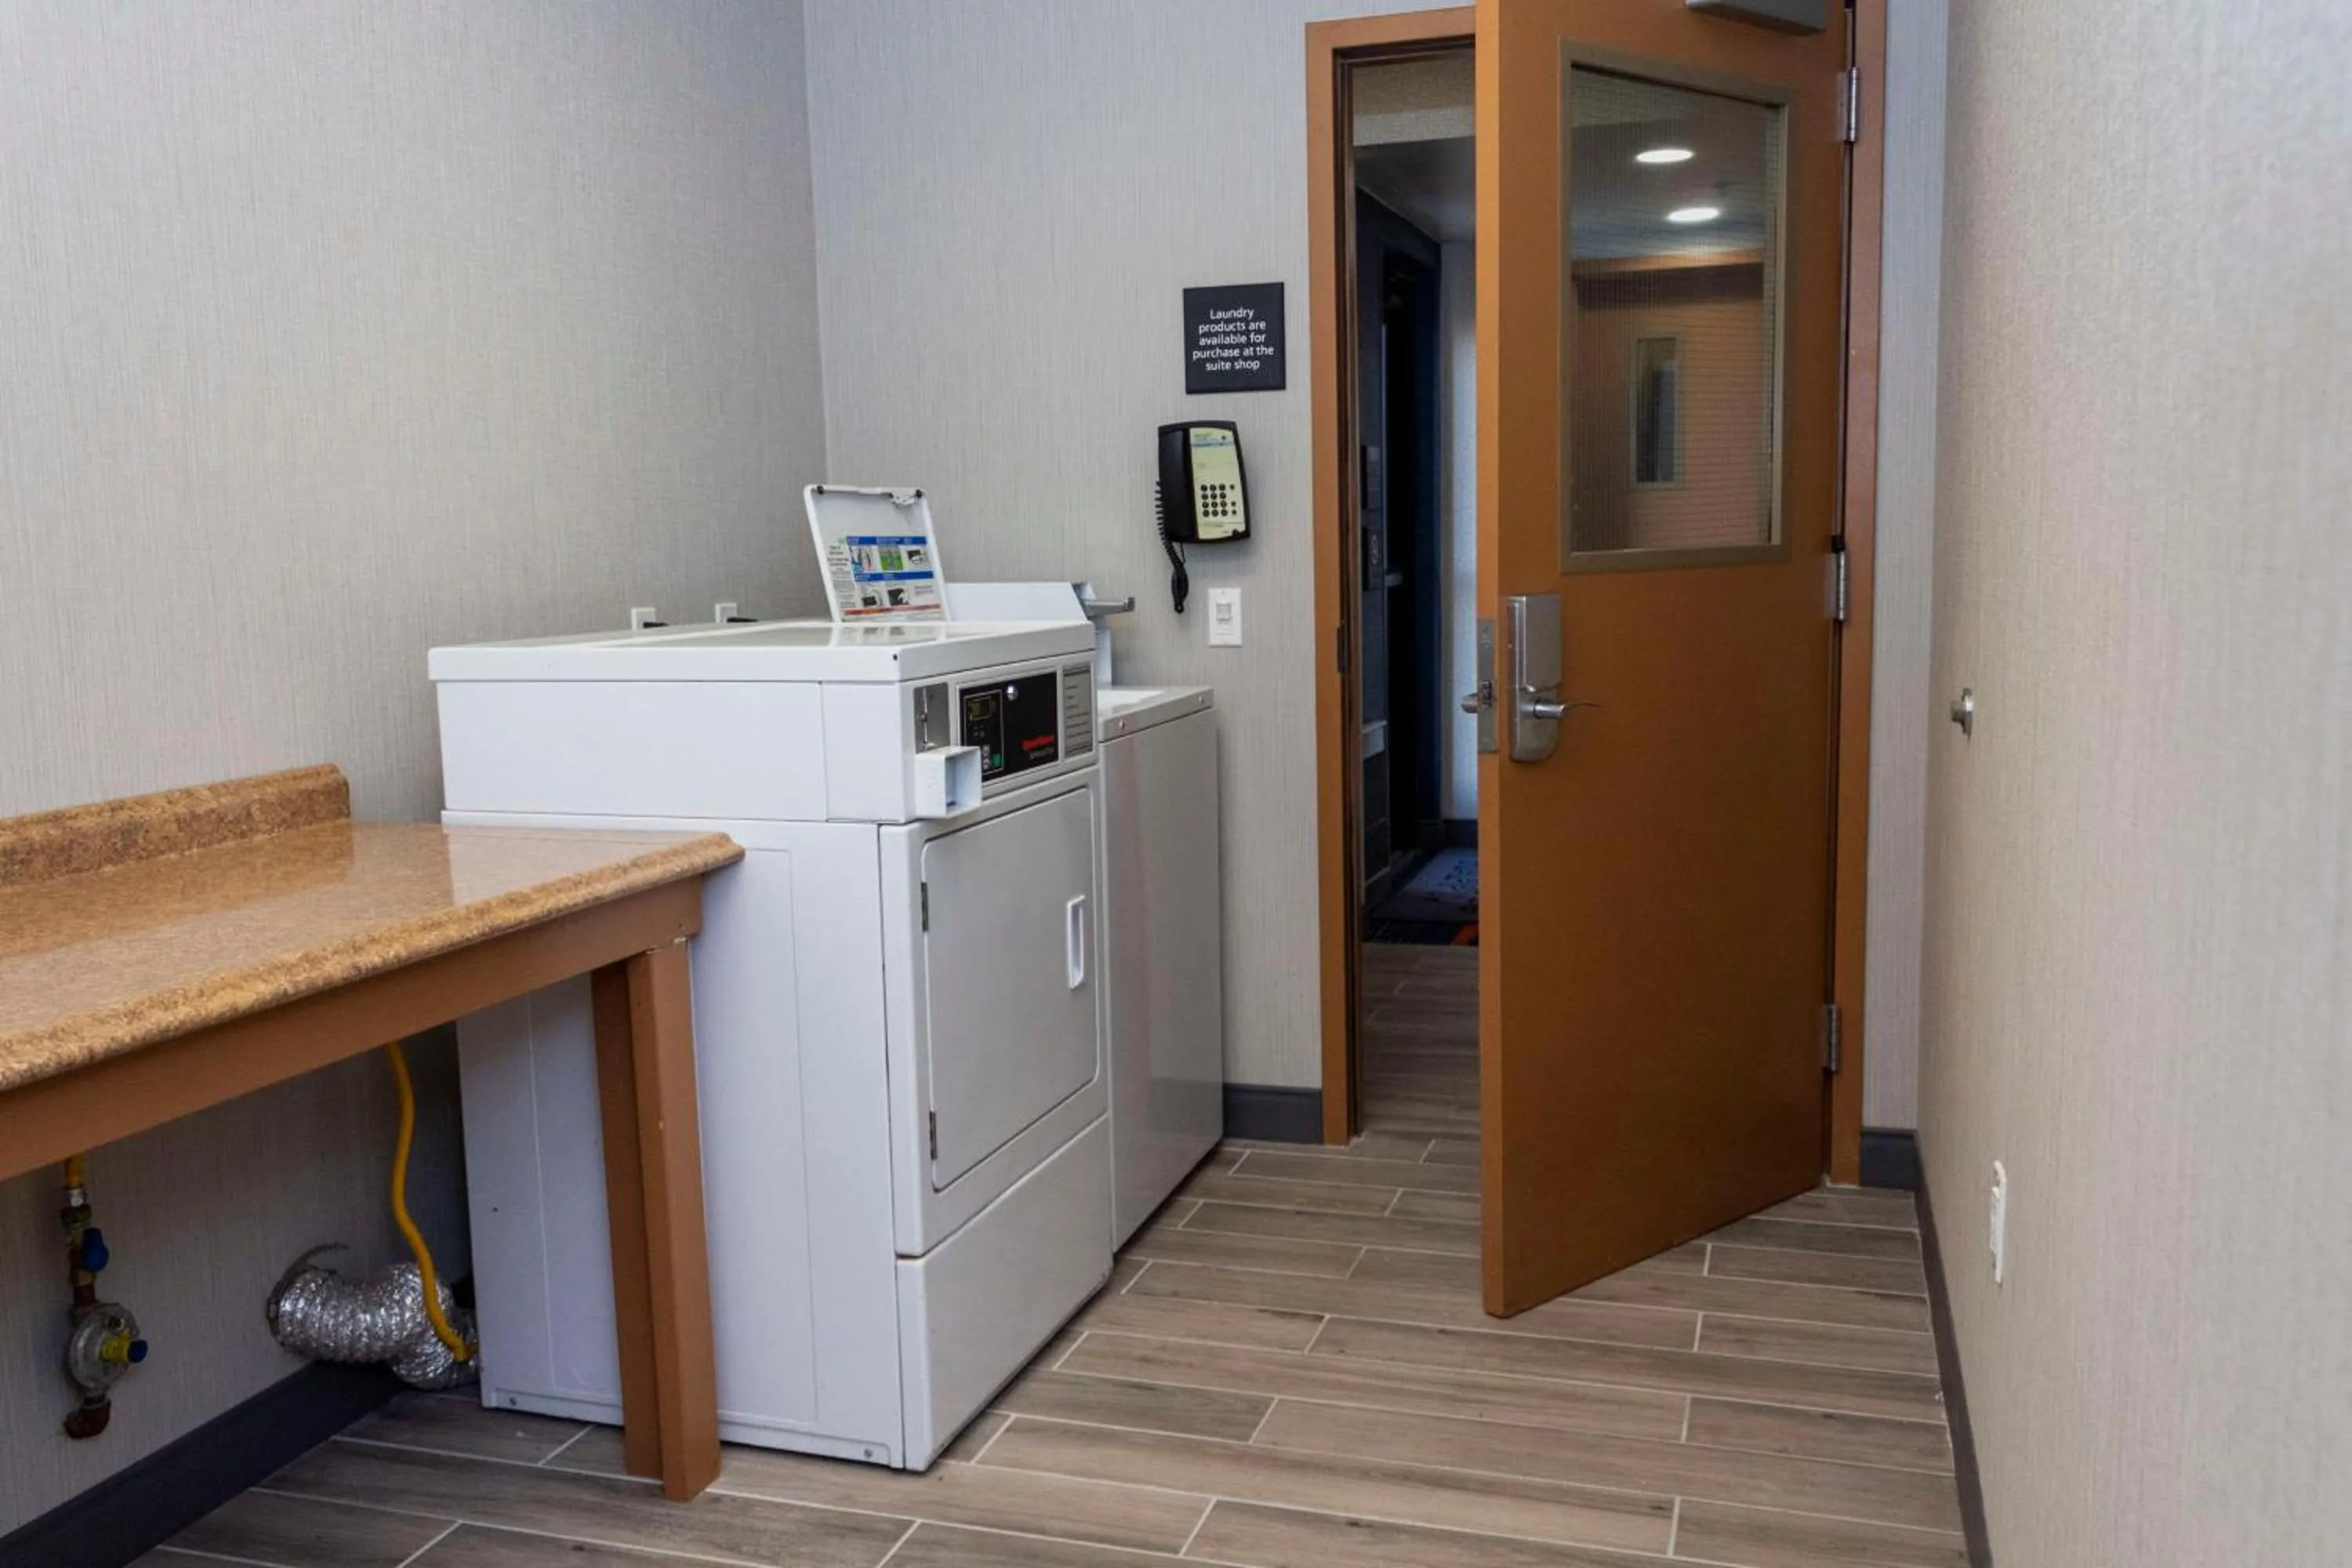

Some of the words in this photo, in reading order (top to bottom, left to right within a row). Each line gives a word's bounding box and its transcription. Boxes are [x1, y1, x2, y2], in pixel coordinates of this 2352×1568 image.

[1210, 307, 1254, 320] Laundry
[1199, 321, 1245, 334] products
[1249, 321, 1266, 330] are
[1199, 334, 1247, 346] available
[1250, 332, 1266, 343] for
[1192, 347, 1240, 361] purchase
[1243, 346, 1254, 356] at
[1256, 345, 1274, 355] the
[1205, 360, 1232, 371] suite
[1234, 358, 1260, 371] shop
